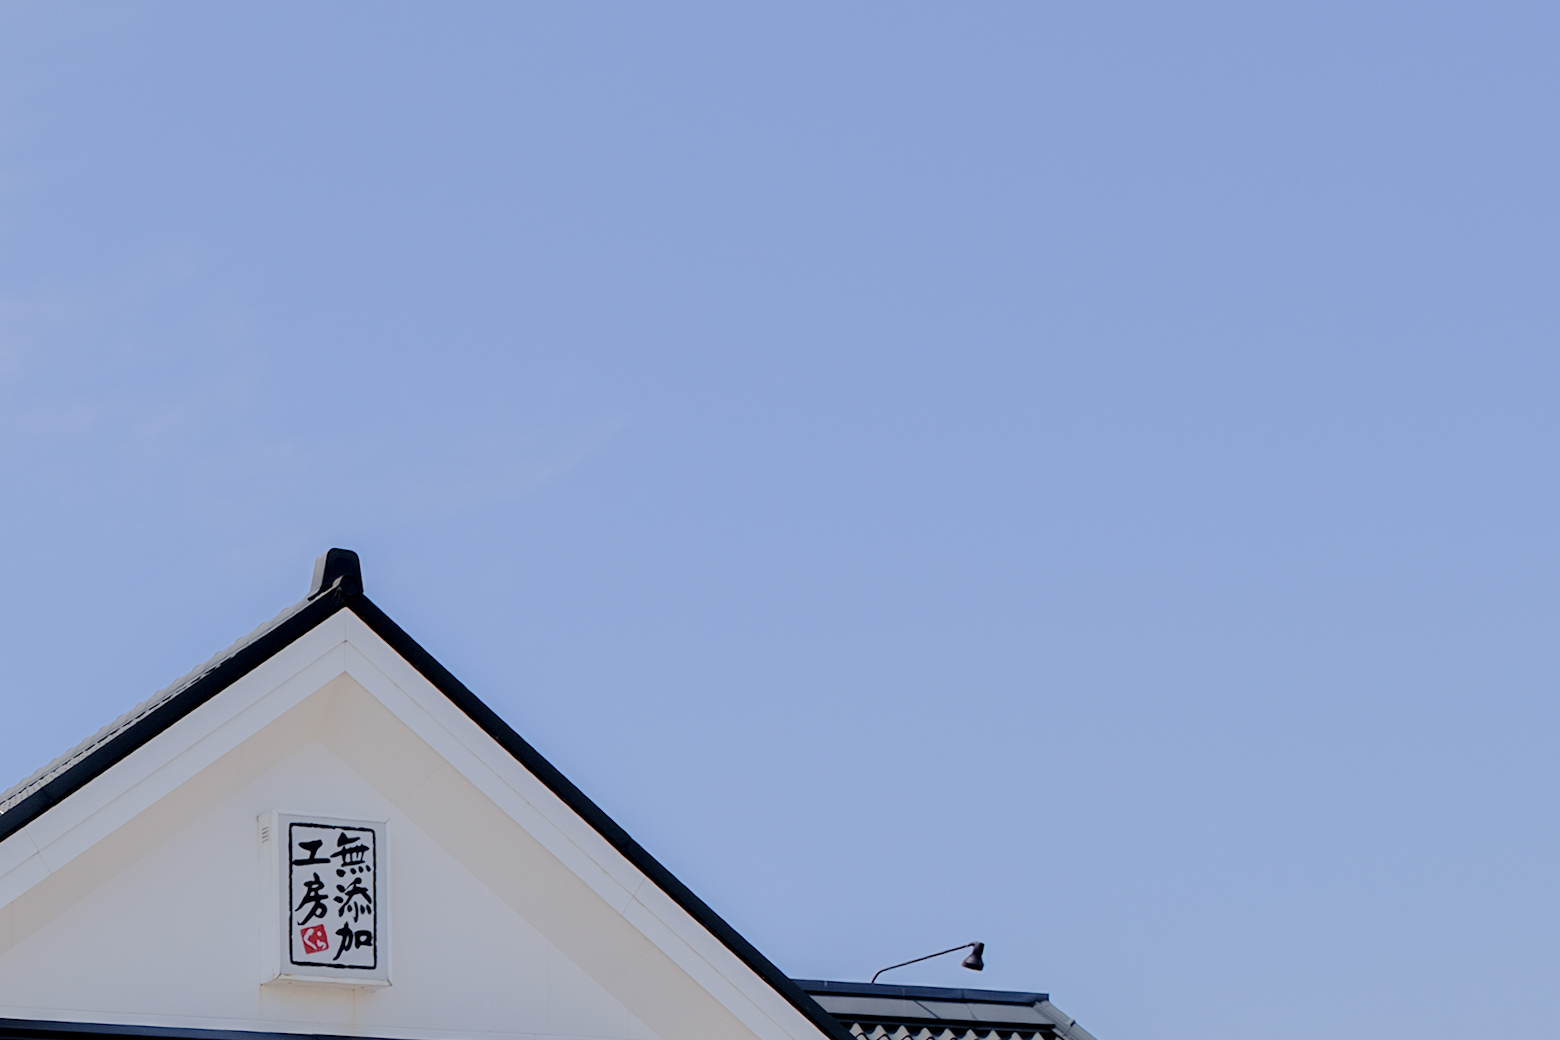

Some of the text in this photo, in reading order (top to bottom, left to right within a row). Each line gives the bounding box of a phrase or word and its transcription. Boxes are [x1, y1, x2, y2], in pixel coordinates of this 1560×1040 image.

[292, 840, 331, 925] 工房
[330, 832, 372, 961] 無添加
[302, 927, 327, 951] くら
